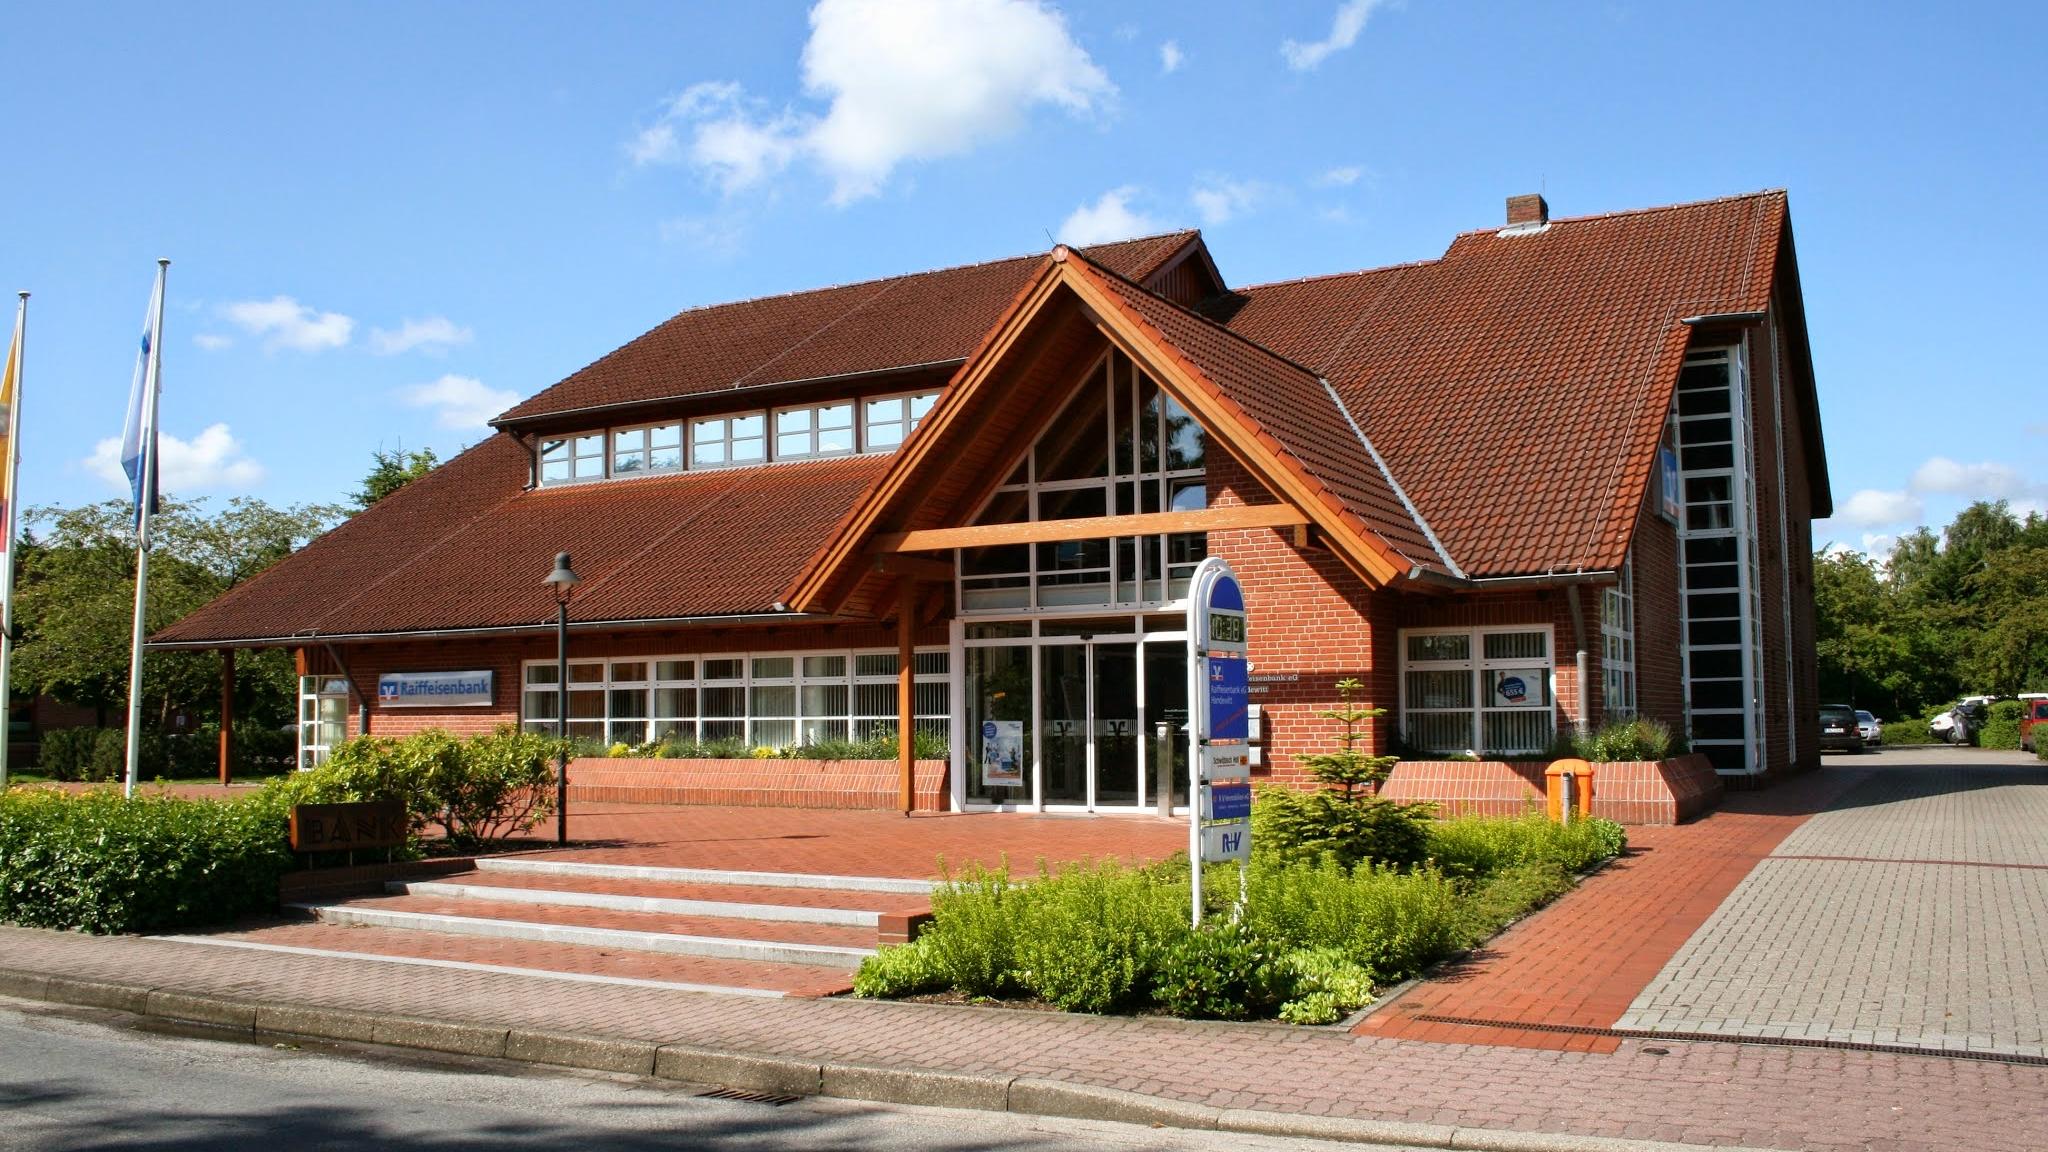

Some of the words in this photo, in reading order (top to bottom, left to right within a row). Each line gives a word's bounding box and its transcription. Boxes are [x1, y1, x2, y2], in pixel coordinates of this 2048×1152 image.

[1212, 615, 1240, 641] 10:38
[400, 678, 489, 697] Raiffeisenbank
[1248, 674, 1286, 682] eisenbank
[304, 813, 402, 844] BANK
[1222, 831, 1242, 853] R+V
